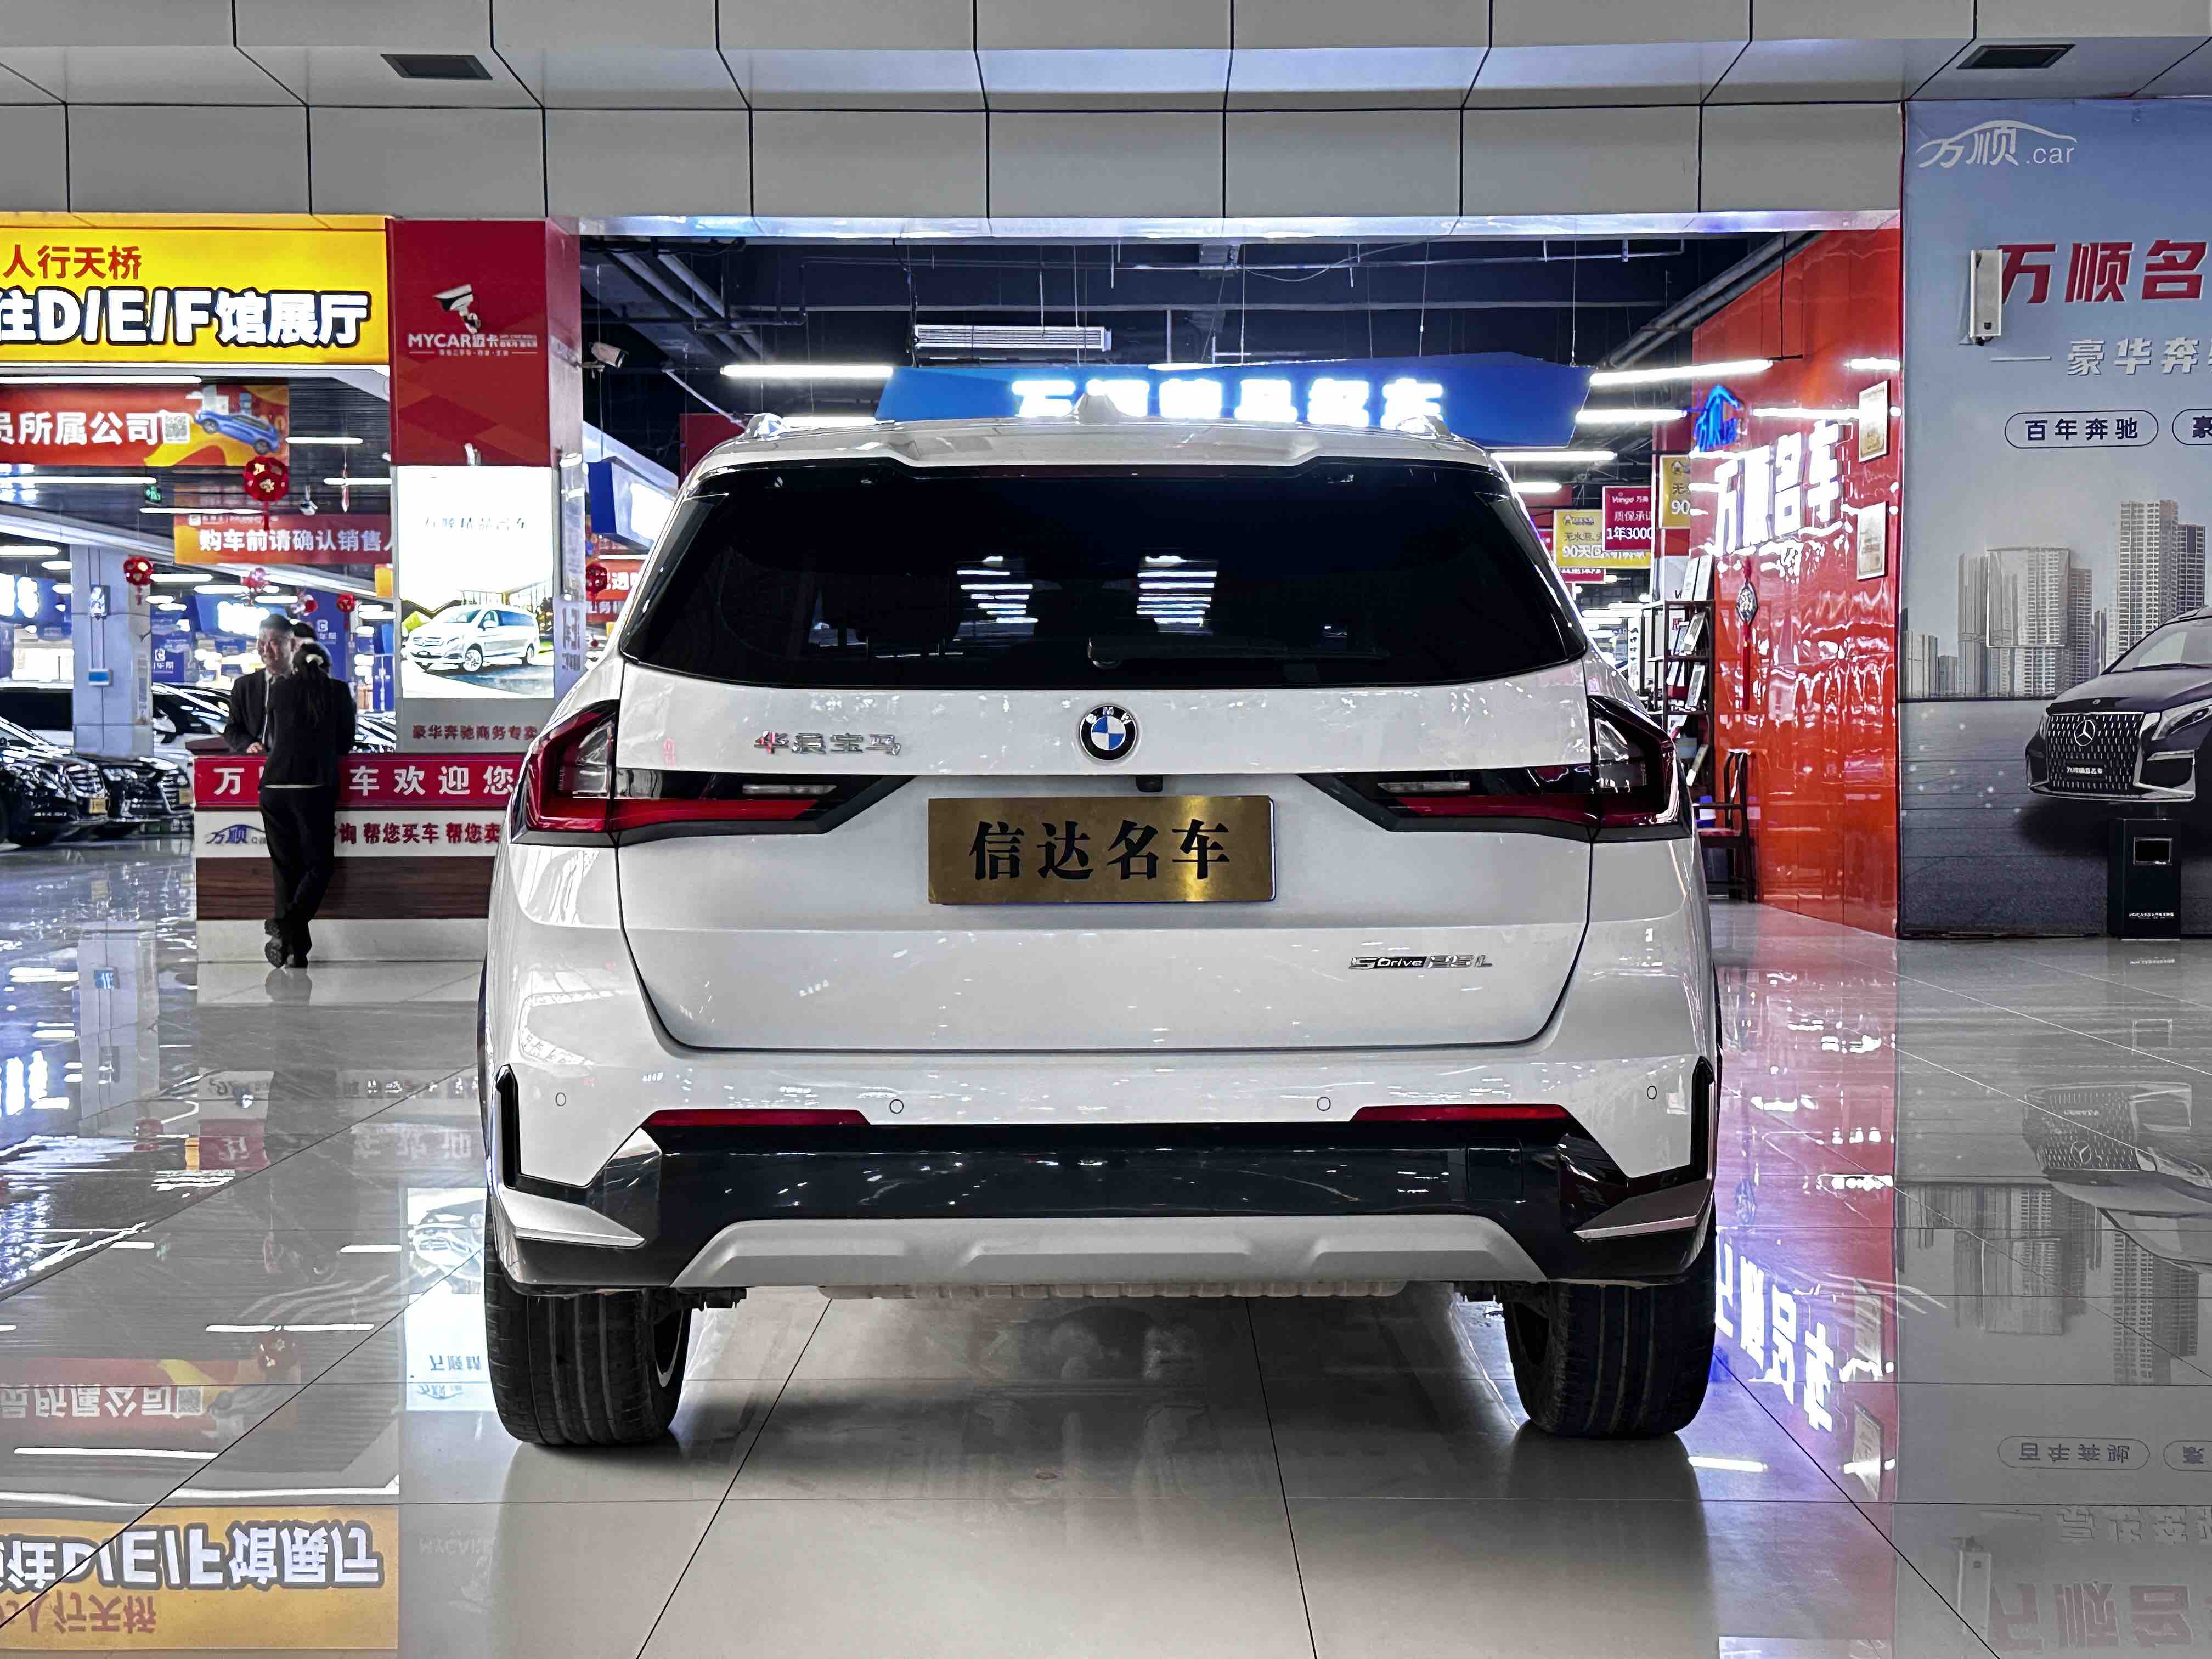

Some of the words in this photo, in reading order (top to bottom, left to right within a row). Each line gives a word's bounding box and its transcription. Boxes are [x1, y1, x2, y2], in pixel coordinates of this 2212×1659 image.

[3, 244, 142, 279] 人行天桥
[408, 333, 471, 347] MYCAR
[2068, 337, 2212, 376] 豪华奔
[2025, 417, 2138, 441] 百年奔驰
[754, 730, 901, 756] 华晨宝马
[968, 819, 1231, 881] 信达名车
